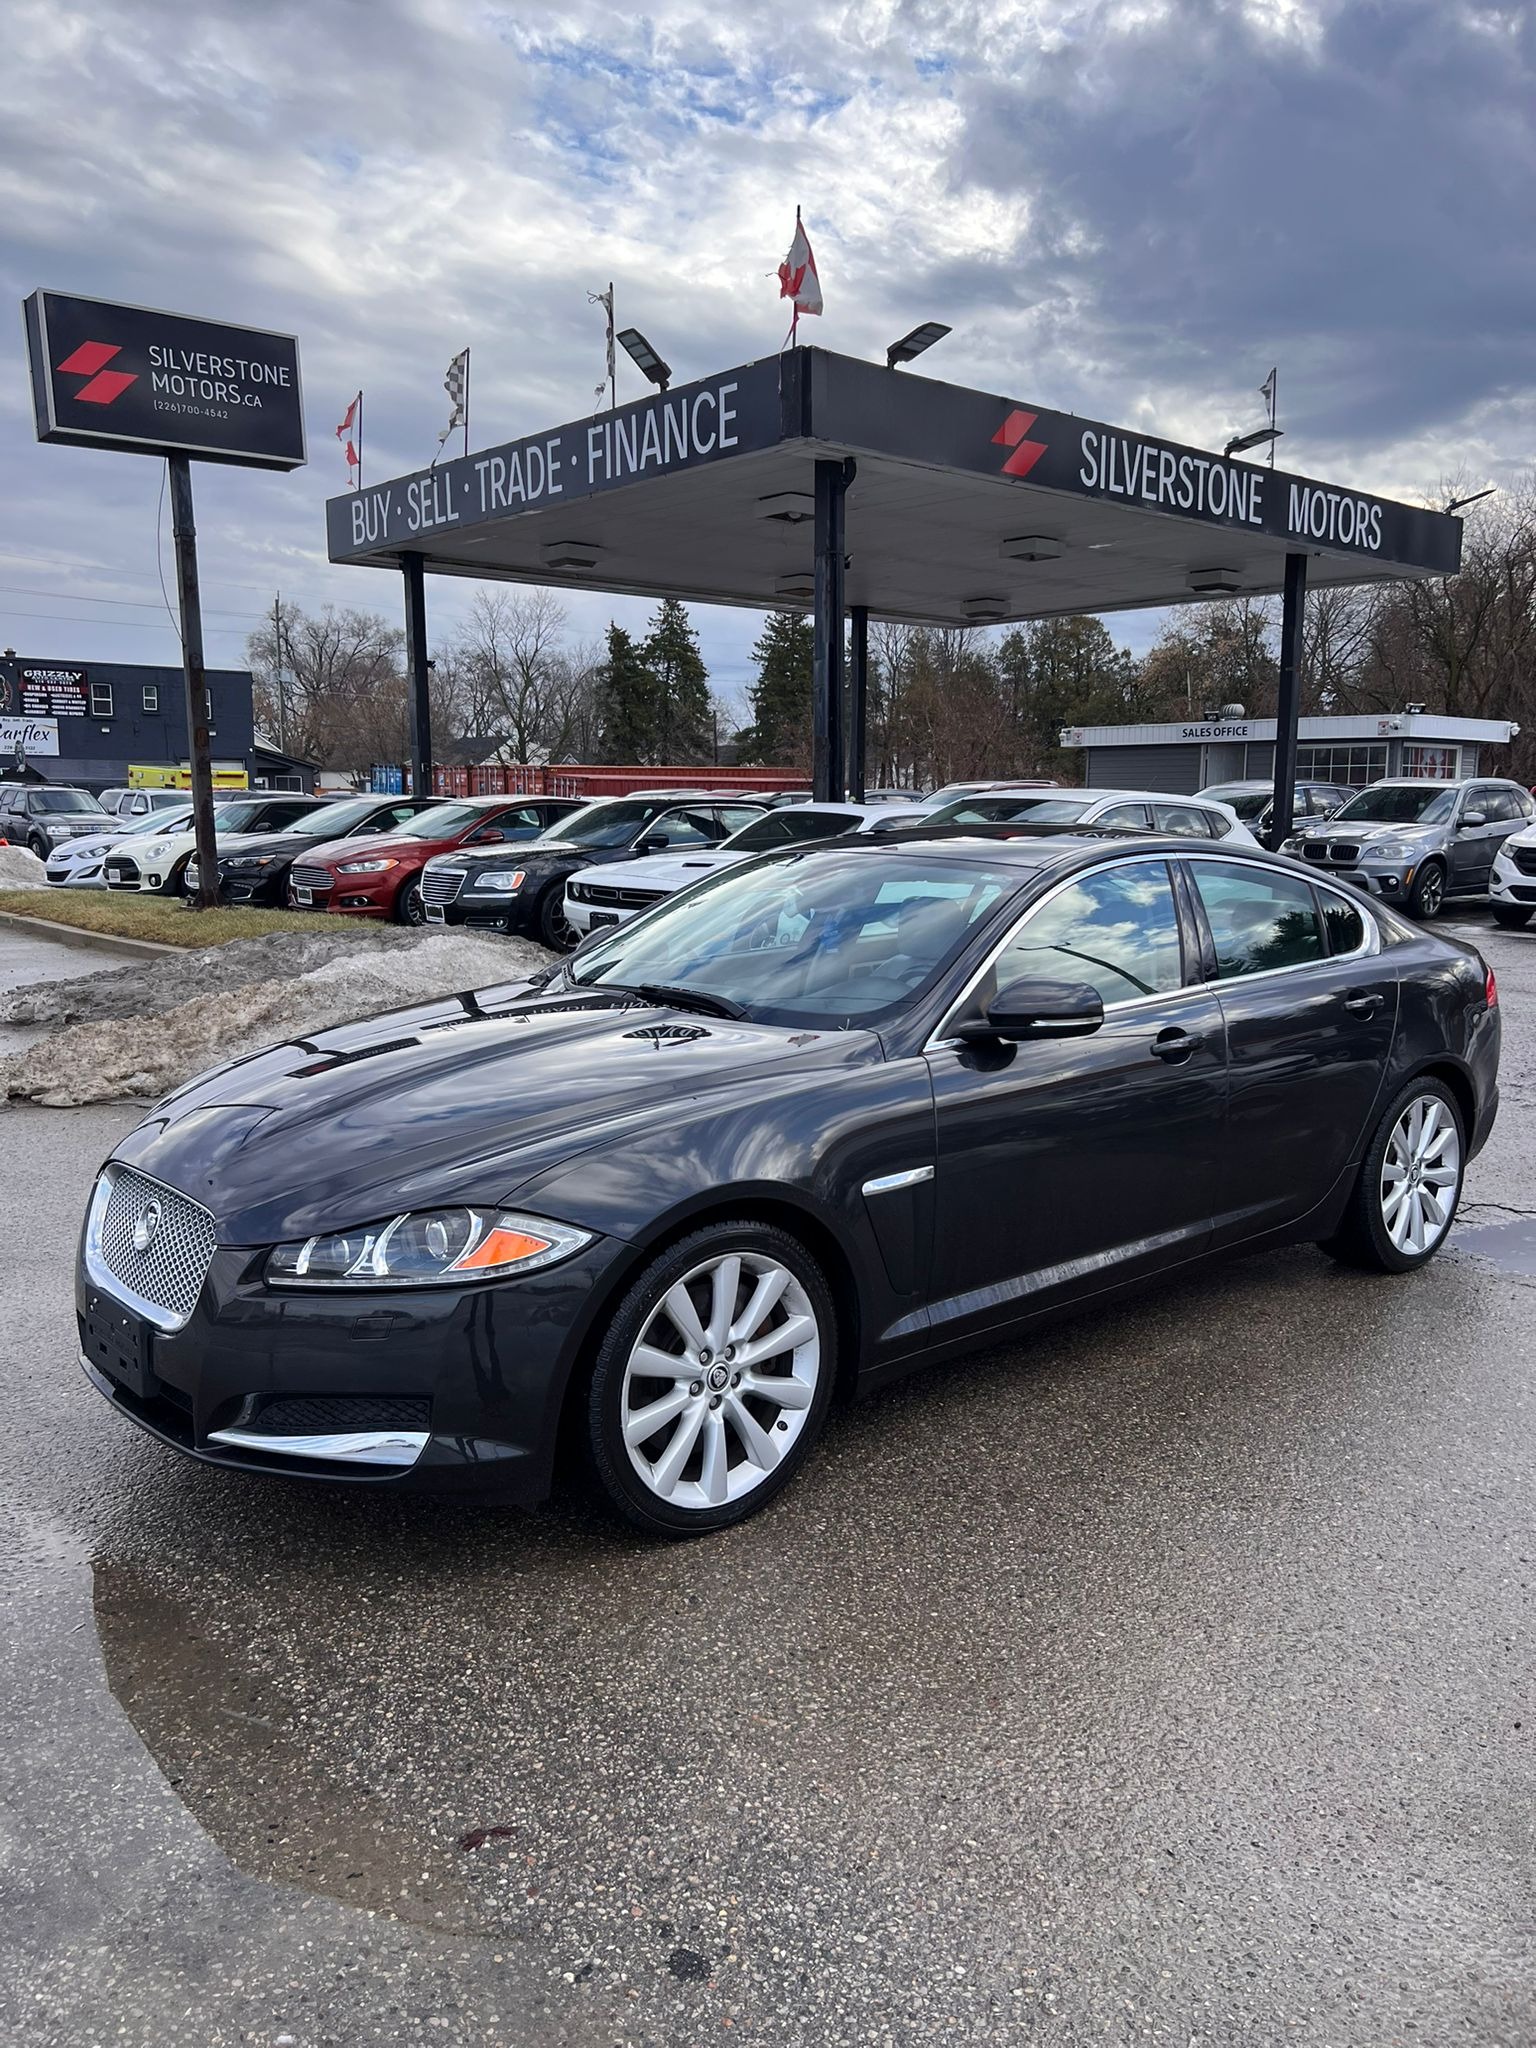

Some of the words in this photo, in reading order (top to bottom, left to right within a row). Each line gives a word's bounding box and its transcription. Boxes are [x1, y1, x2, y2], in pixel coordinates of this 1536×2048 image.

[149, 345, 291, 387] SILVERSTONE
[153, 400, 229, 420] (226)700-4542
[351, 490, 392, 546] BUY
[407, 472, 460, 531] SELL
[475, 437, 563, 513] TRADE
[587, 382, 739, 484] FINANCE
[1079, 429, 1265, 526] SILVERSTONE
[1288, 483, 1383, 551] MOTORS
[24, 670, 82, 680] GRIZZLY
[1182, 727, 1212, 738] SALES
[1213, 726, 1248, 737] OFFICE
